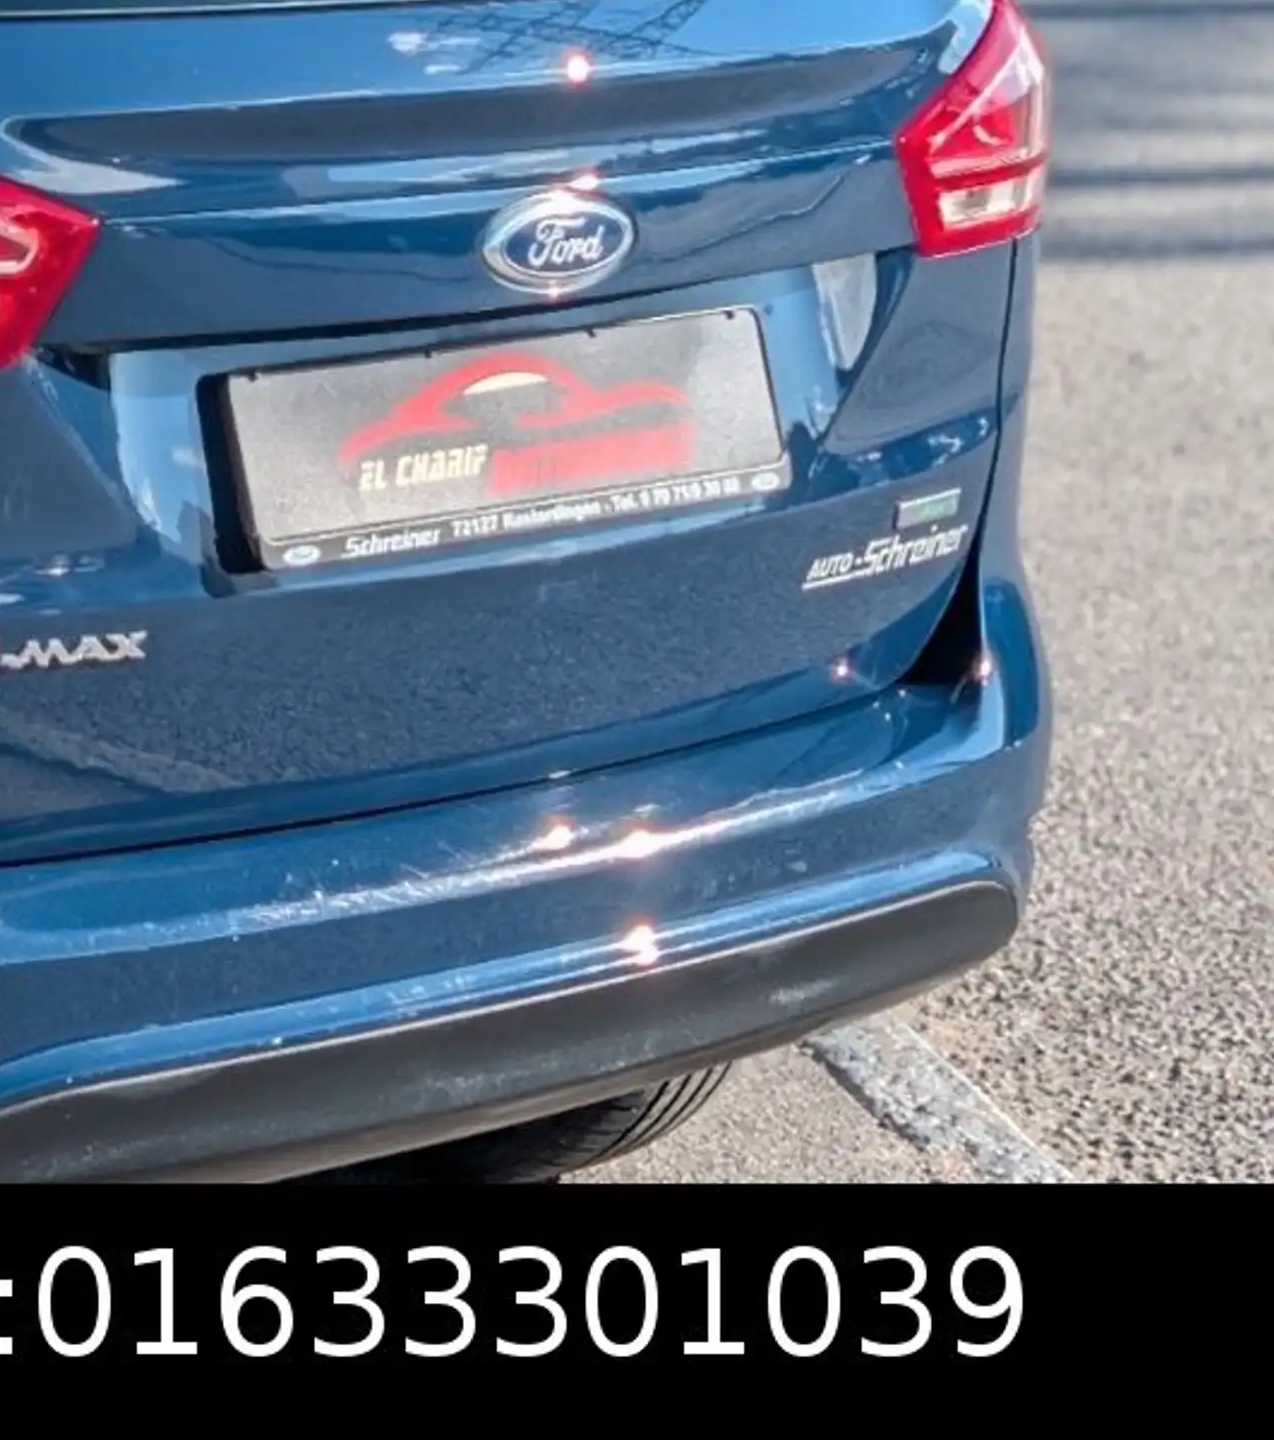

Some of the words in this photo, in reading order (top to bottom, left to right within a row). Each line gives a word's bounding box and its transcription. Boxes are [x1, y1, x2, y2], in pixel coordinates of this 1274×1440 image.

[527, 216, 607, 270] Ford
[359, 460, 388, 491] EL
[395, 444, 489, 487] CHARIF
[341, 527, 442, 559] Schreiner
